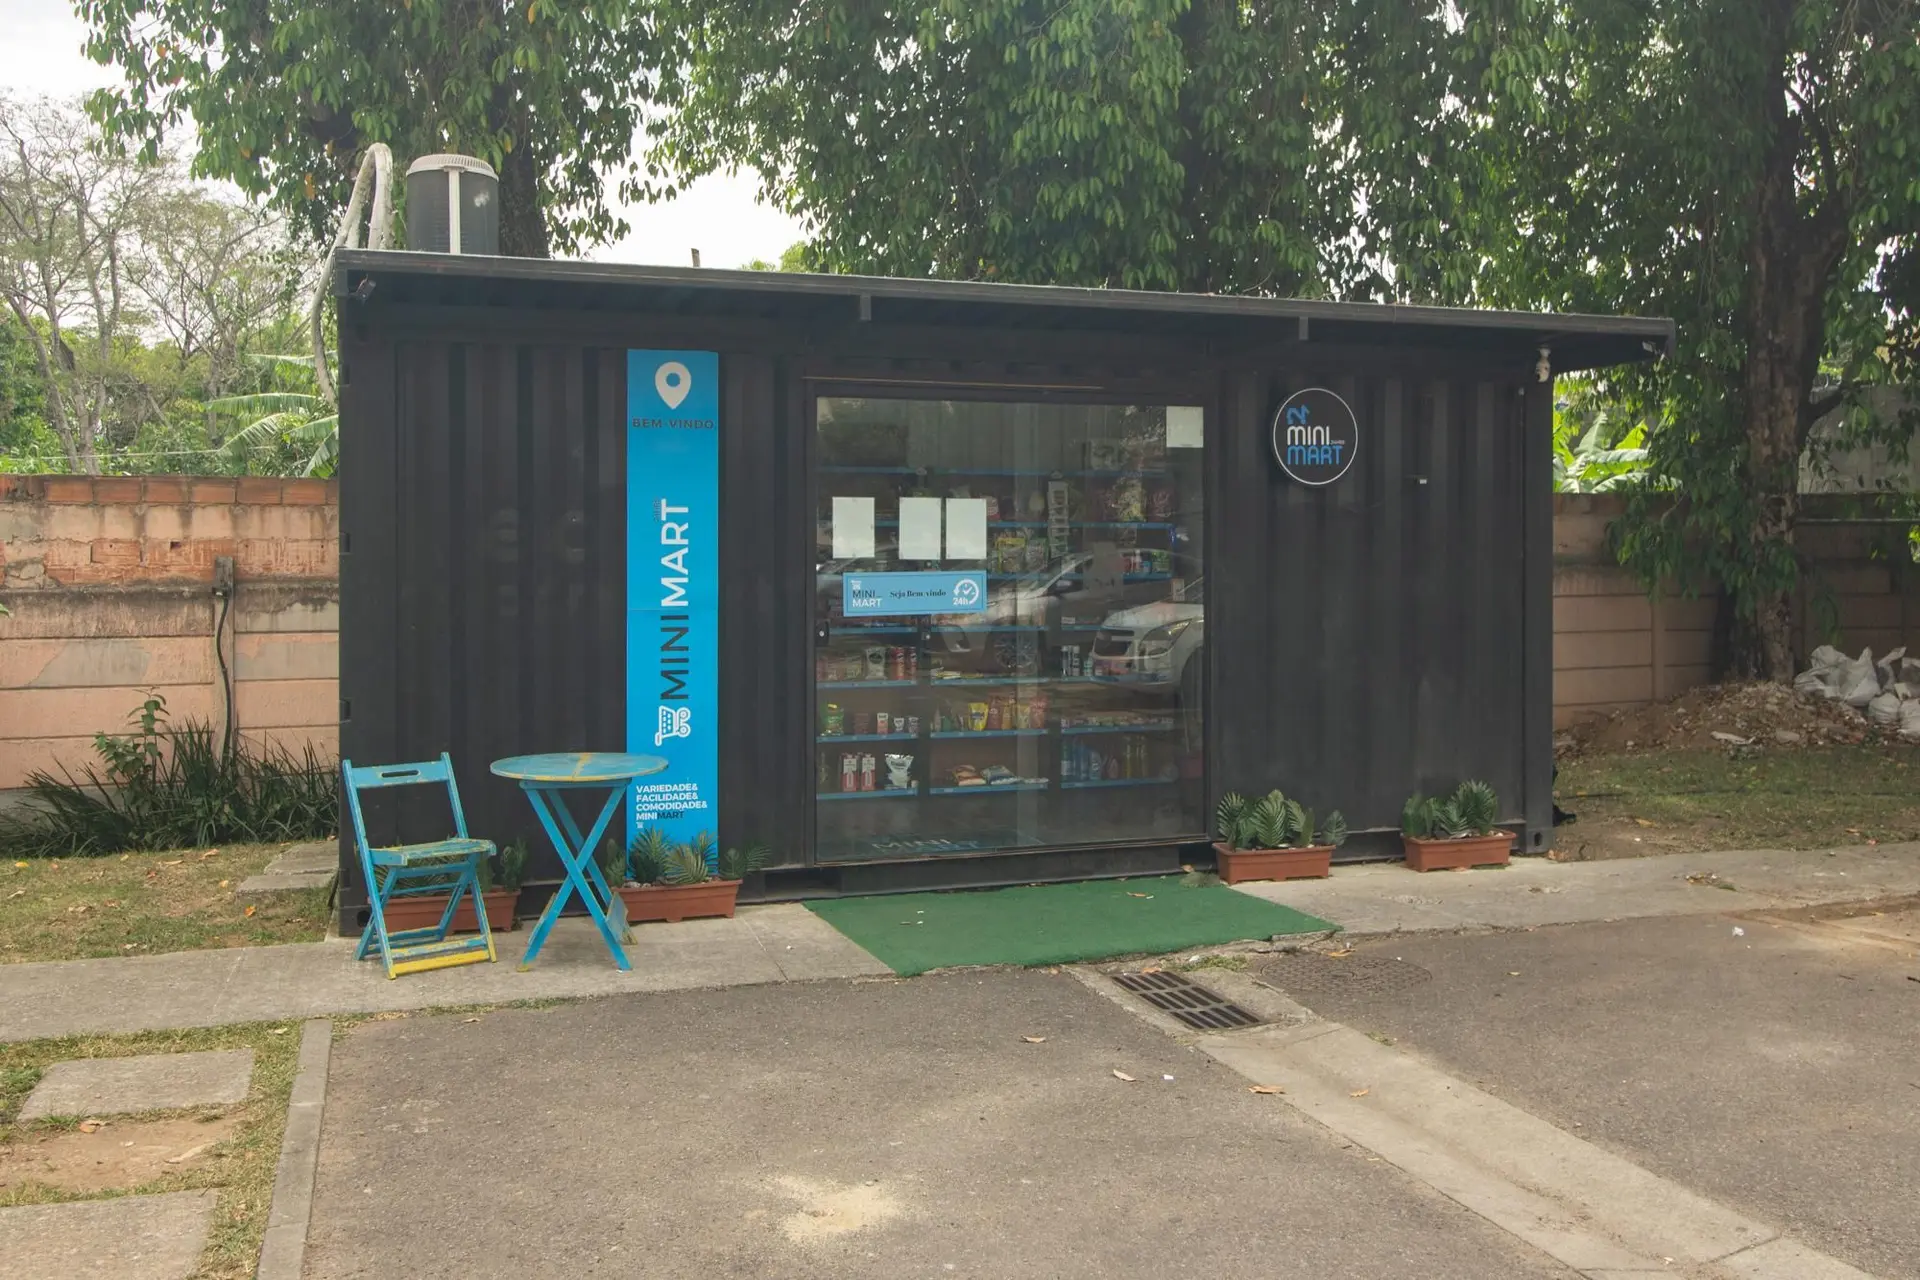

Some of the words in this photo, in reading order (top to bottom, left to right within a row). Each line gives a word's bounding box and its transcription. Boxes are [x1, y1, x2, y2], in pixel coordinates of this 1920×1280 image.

[1287, 426, 1330, 445] MINI
[1287, 445, 1344, 465] MART
[852, 589, 876, 598] MINI
[890, 591, 906, 600] Seja
[852, 598, 883, 608] MART
[953, 597, 969, 606] 24h
